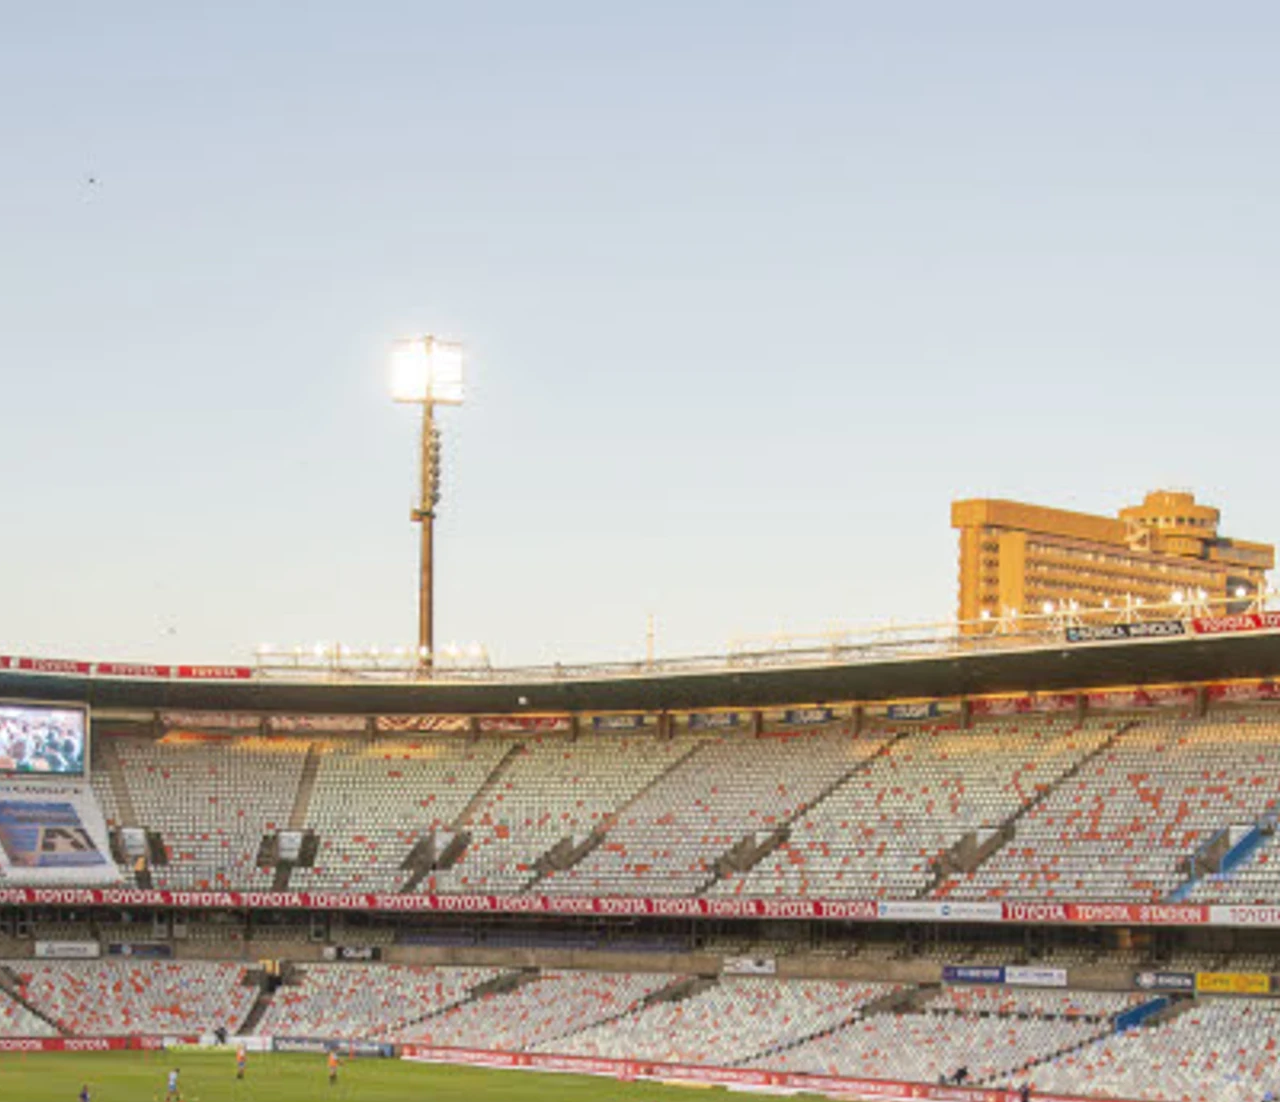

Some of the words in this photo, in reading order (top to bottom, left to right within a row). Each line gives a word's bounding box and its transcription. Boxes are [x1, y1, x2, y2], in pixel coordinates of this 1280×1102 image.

[34, 889, 94, 903] TOYOTA
[102, 891, 161, 905] TOYOTA
[171, 892, 231, 906] TOYOTA
[240, 892, 301, 906] TOYOTA
[308, 893, 368, 907] TOYOTA
[376, 896, 430, 909] TOYOTA
[437, 896, 490, 909] TOYOTA
[652, 899, 701, 913] TOYOTA
[764, 900, 813, 914] TOYOTA
[821, 902, 872, 915] TOYOTA
[1009, 904, 1064, 918] TOYOTA
